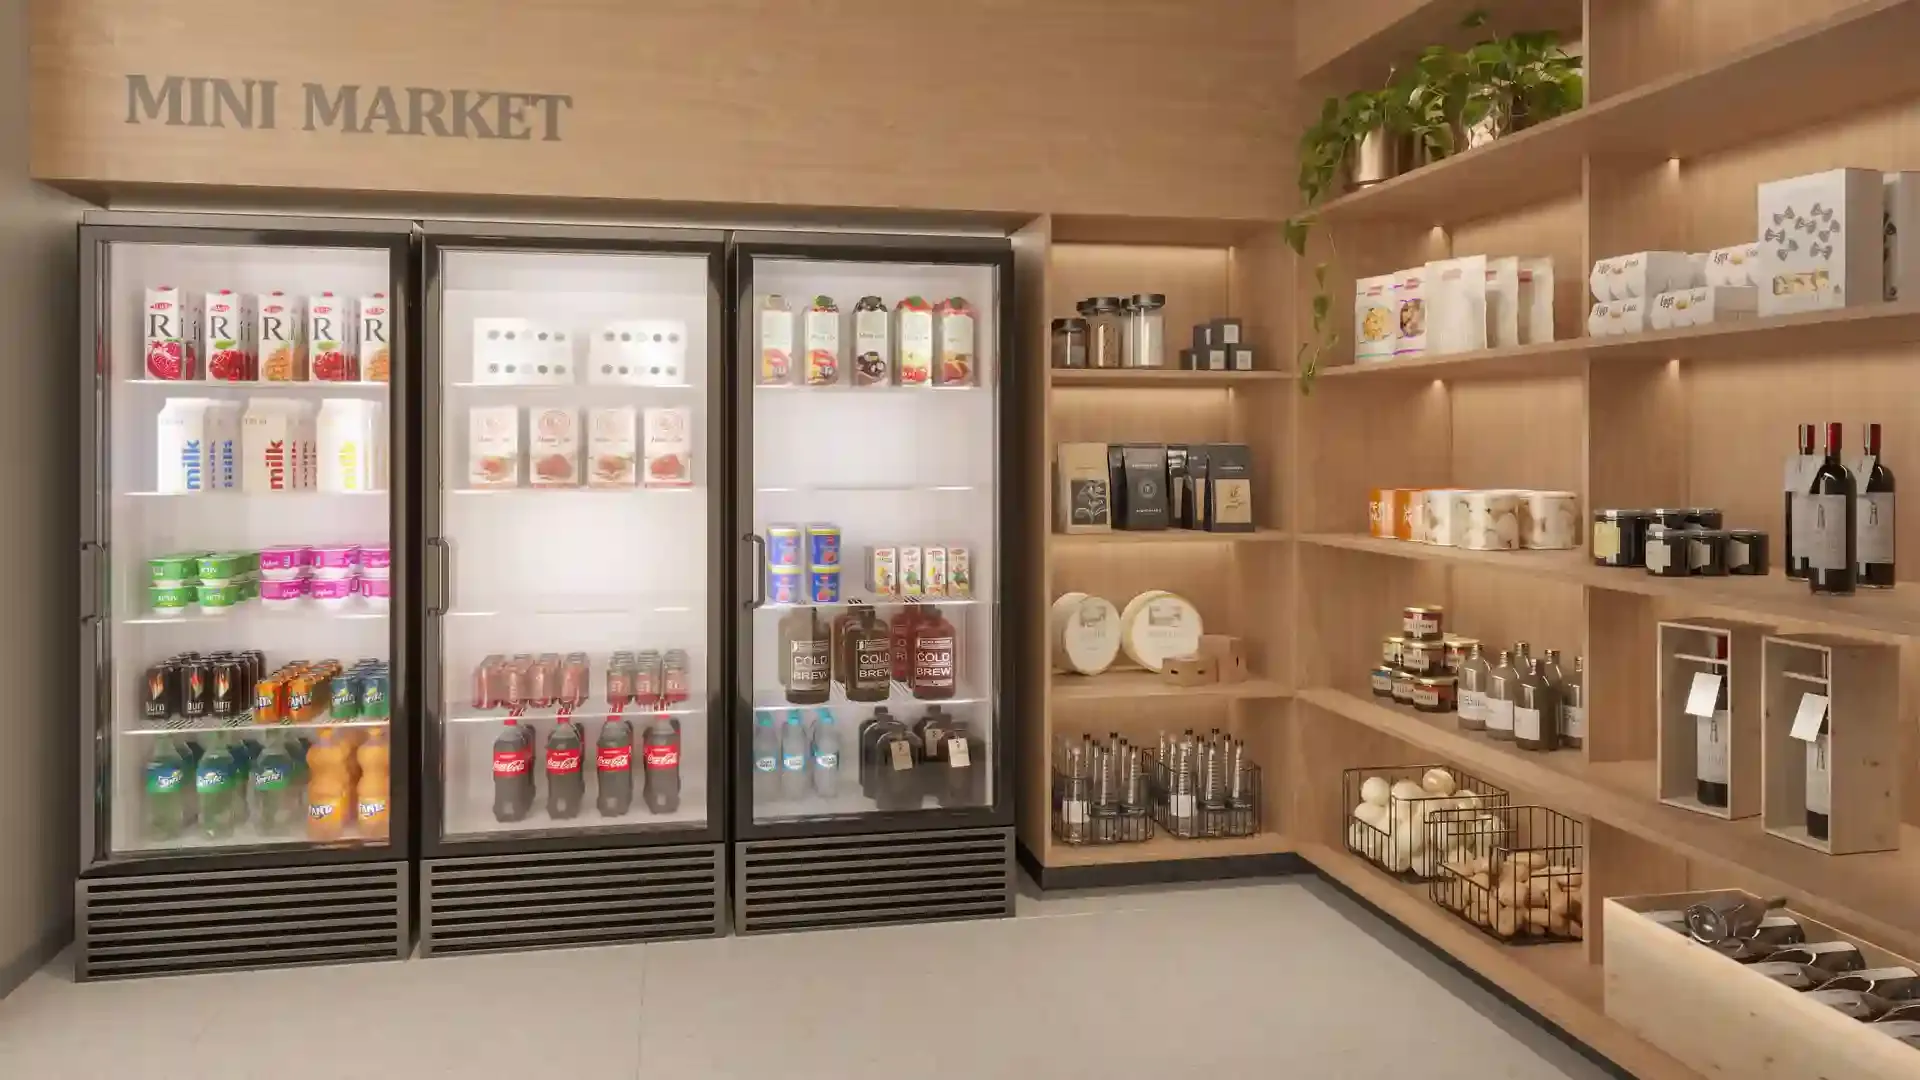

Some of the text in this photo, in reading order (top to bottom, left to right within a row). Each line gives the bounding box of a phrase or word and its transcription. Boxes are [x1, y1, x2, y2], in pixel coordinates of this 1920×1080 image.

[125, 74, 575, 142] MINI MARKET
[182, 440, 200, 490] milk
[265, 440, 284, 490] milk
[794, 655, 828, 665] COLD
[860, 652, 891, 664] COLD
[917, 652, 950, 662] COLD
[793, 671, 827, 680] BREW
[916, 667, 951, 676] BREW
